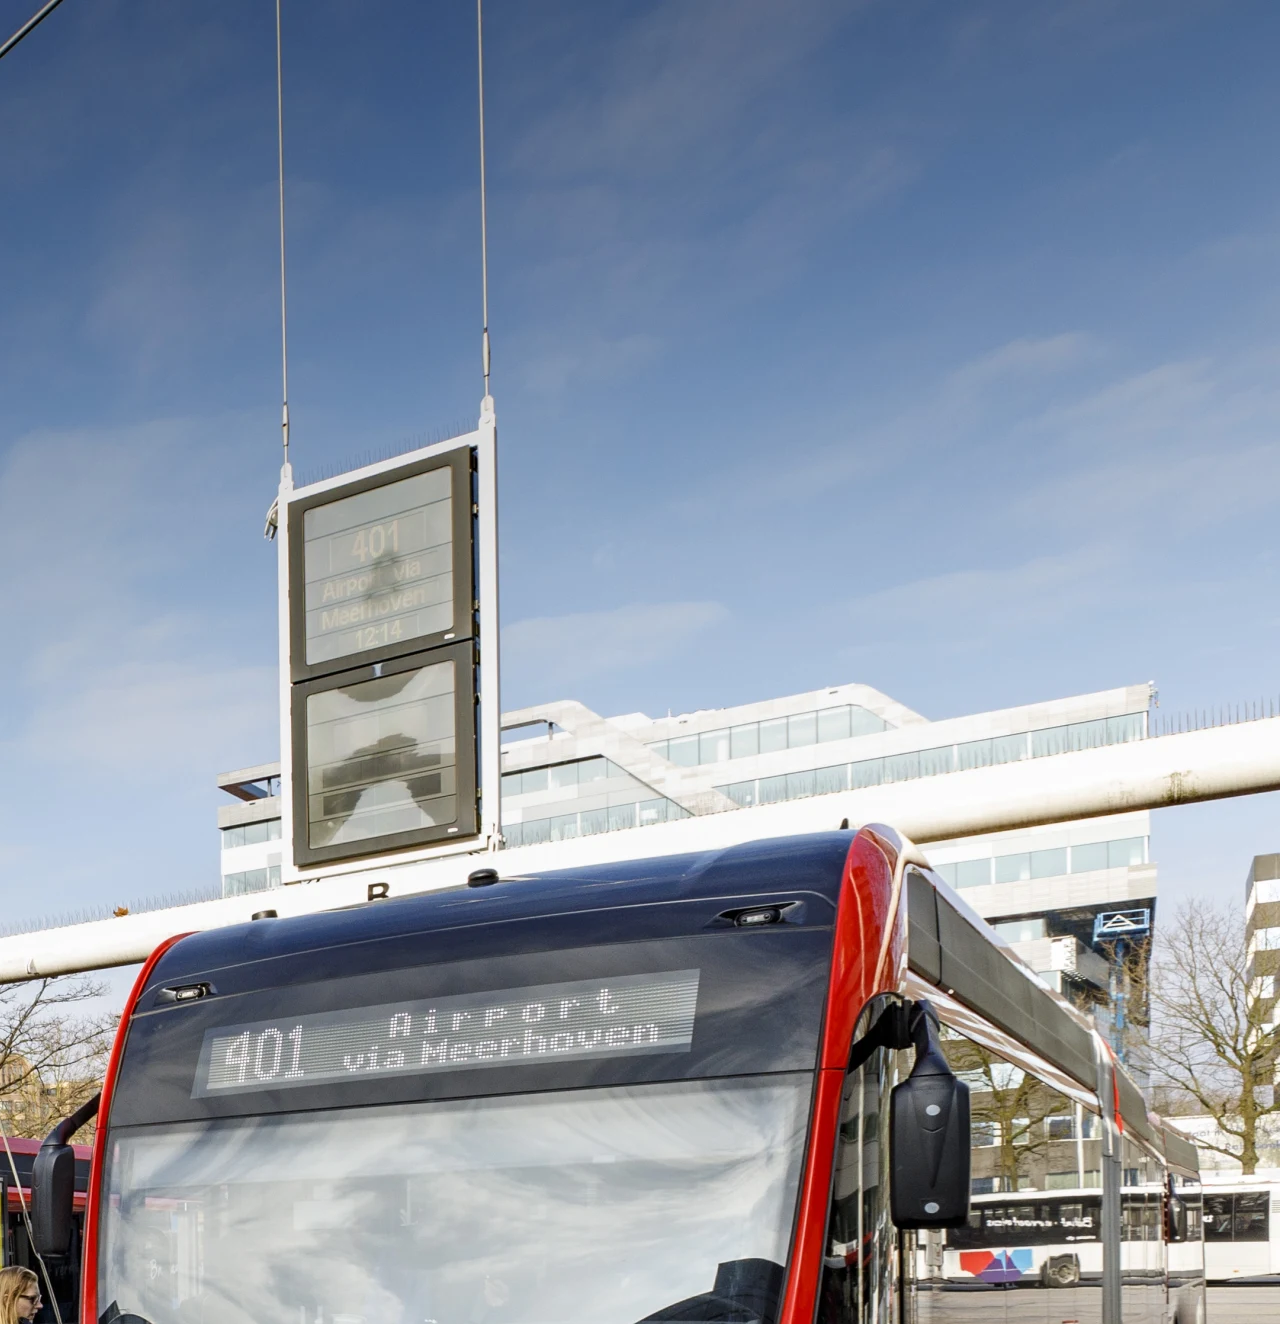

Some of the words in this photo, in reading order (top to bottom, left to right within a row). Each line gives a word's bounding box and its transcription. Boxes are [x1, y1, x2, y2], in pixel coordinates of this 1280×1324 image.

[352, 520, 399, 561] 401
[394, 559, 421, 580] via
[356, 620, 403, 649] 12:14
[389, 988, 620, 1038] Airport
[224, 1025, 305, 1084] 401
[343, 1045, 405, 1072] via
[420, 1022, 660, 1065] Meerhoven
